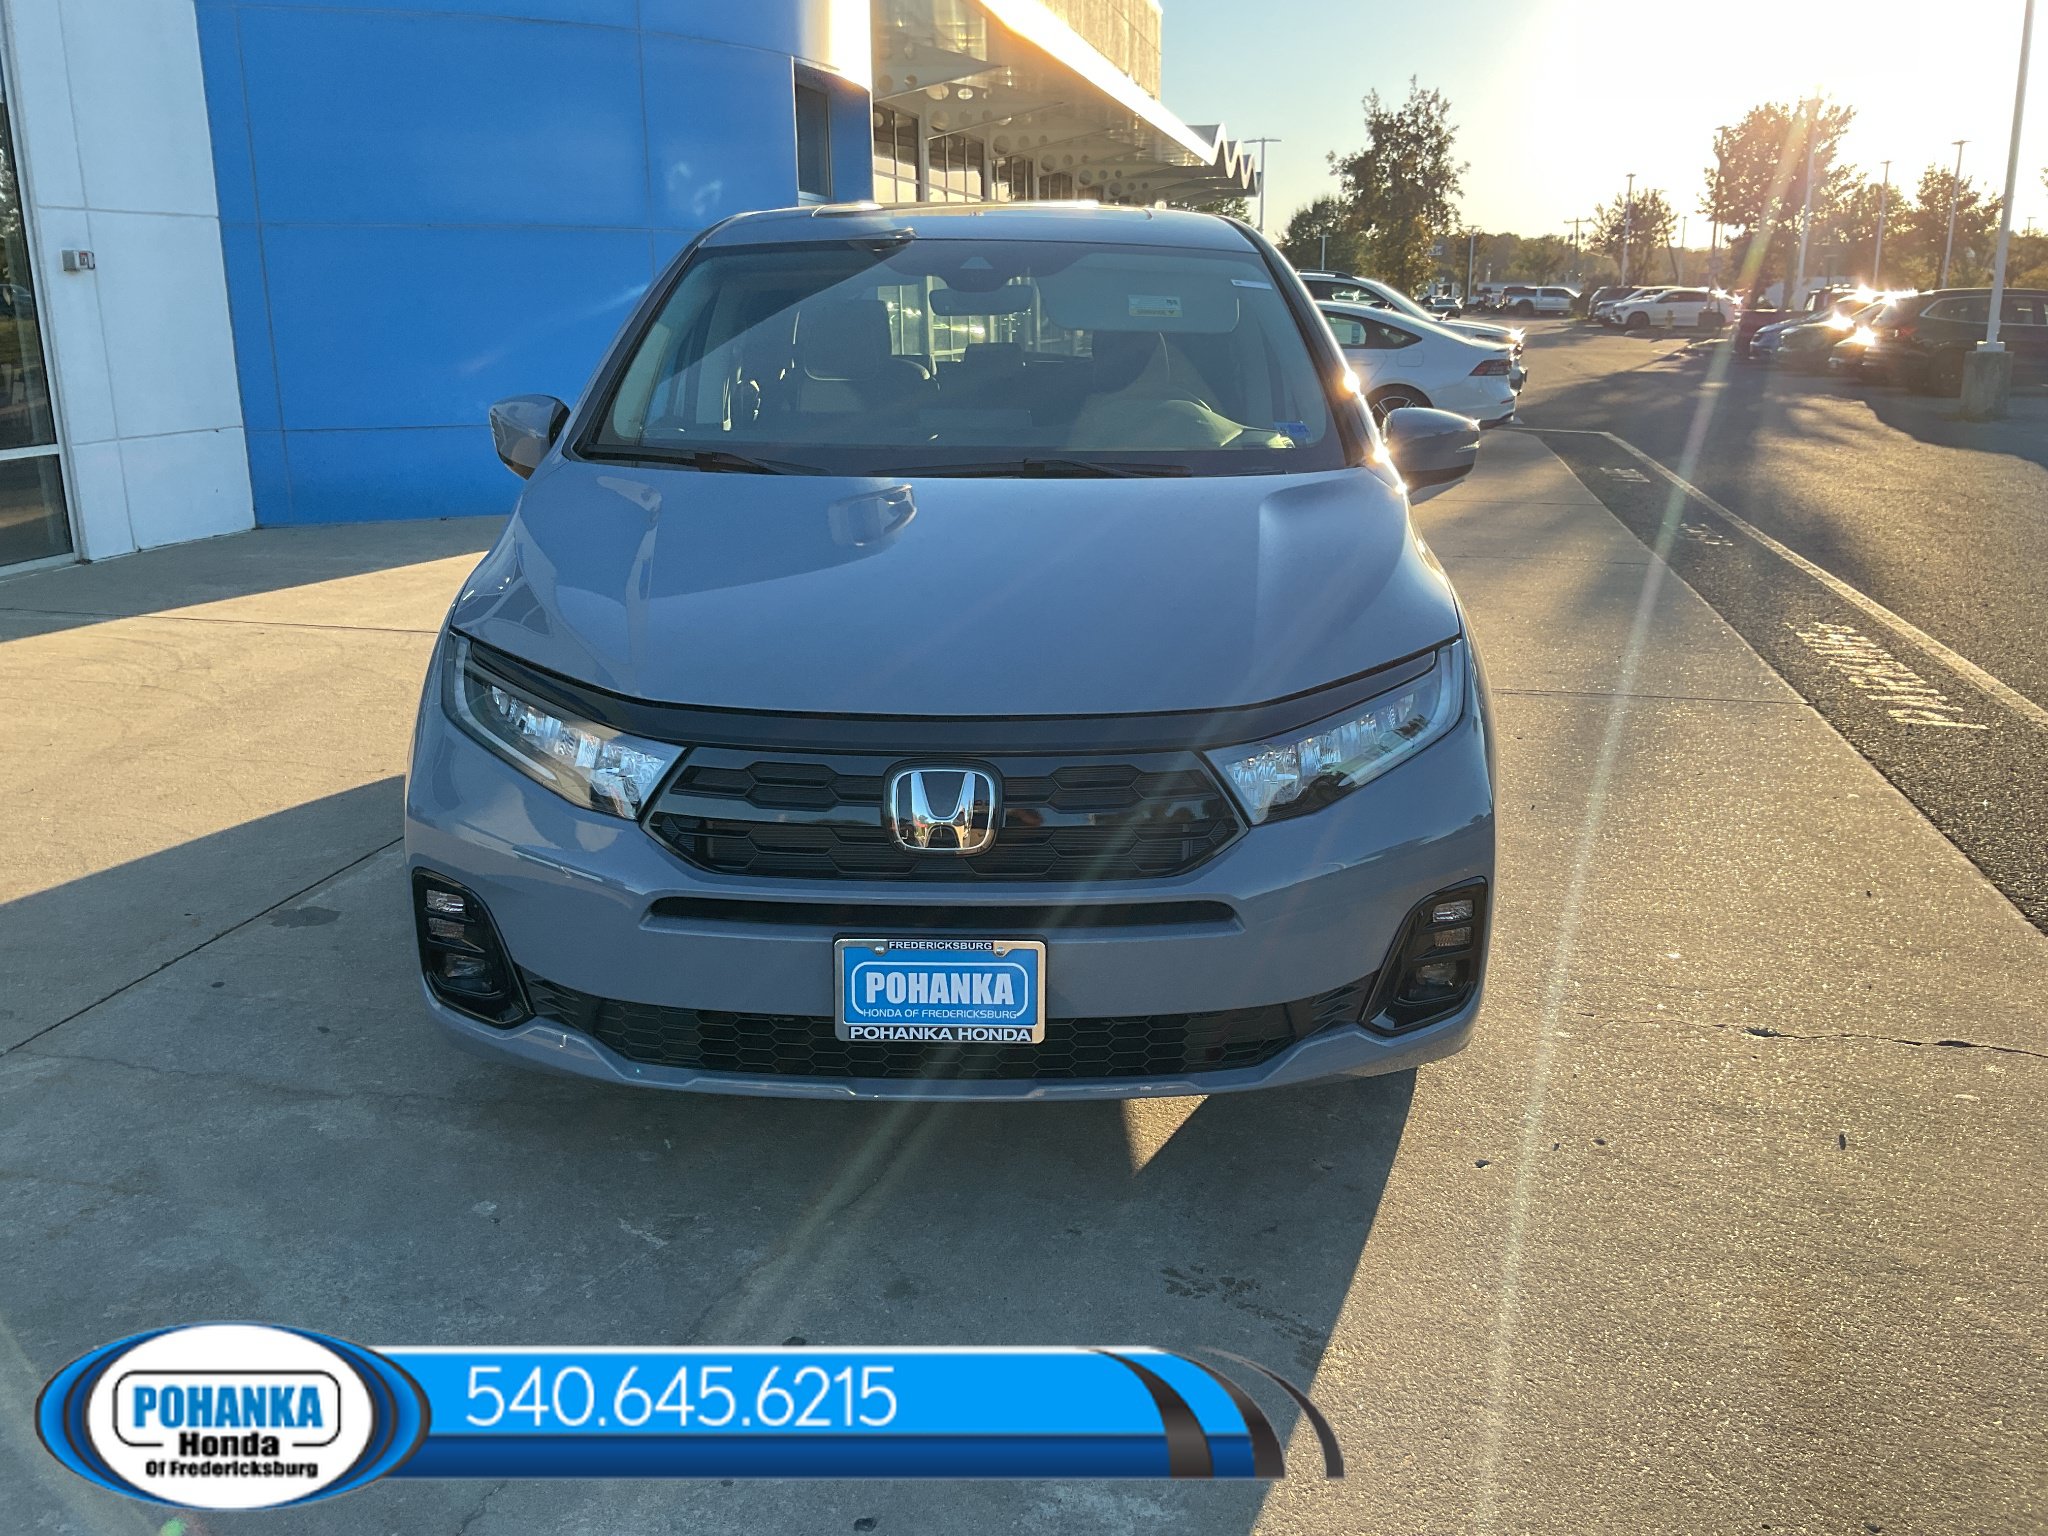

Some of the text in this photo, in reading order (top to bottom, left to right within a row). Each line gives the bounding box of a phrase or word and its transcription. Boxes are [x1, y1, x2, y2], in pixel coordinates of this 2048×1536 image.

[889, 941, 993, 950] FREDERICKSBURG
[866, 971, 1015, 1005] POHANKA
[863, 1008, 1017, 1019] HONDA OF FREDERICKSBURG
[850, 1026, 1032, 1042] POHANKA HONDA
